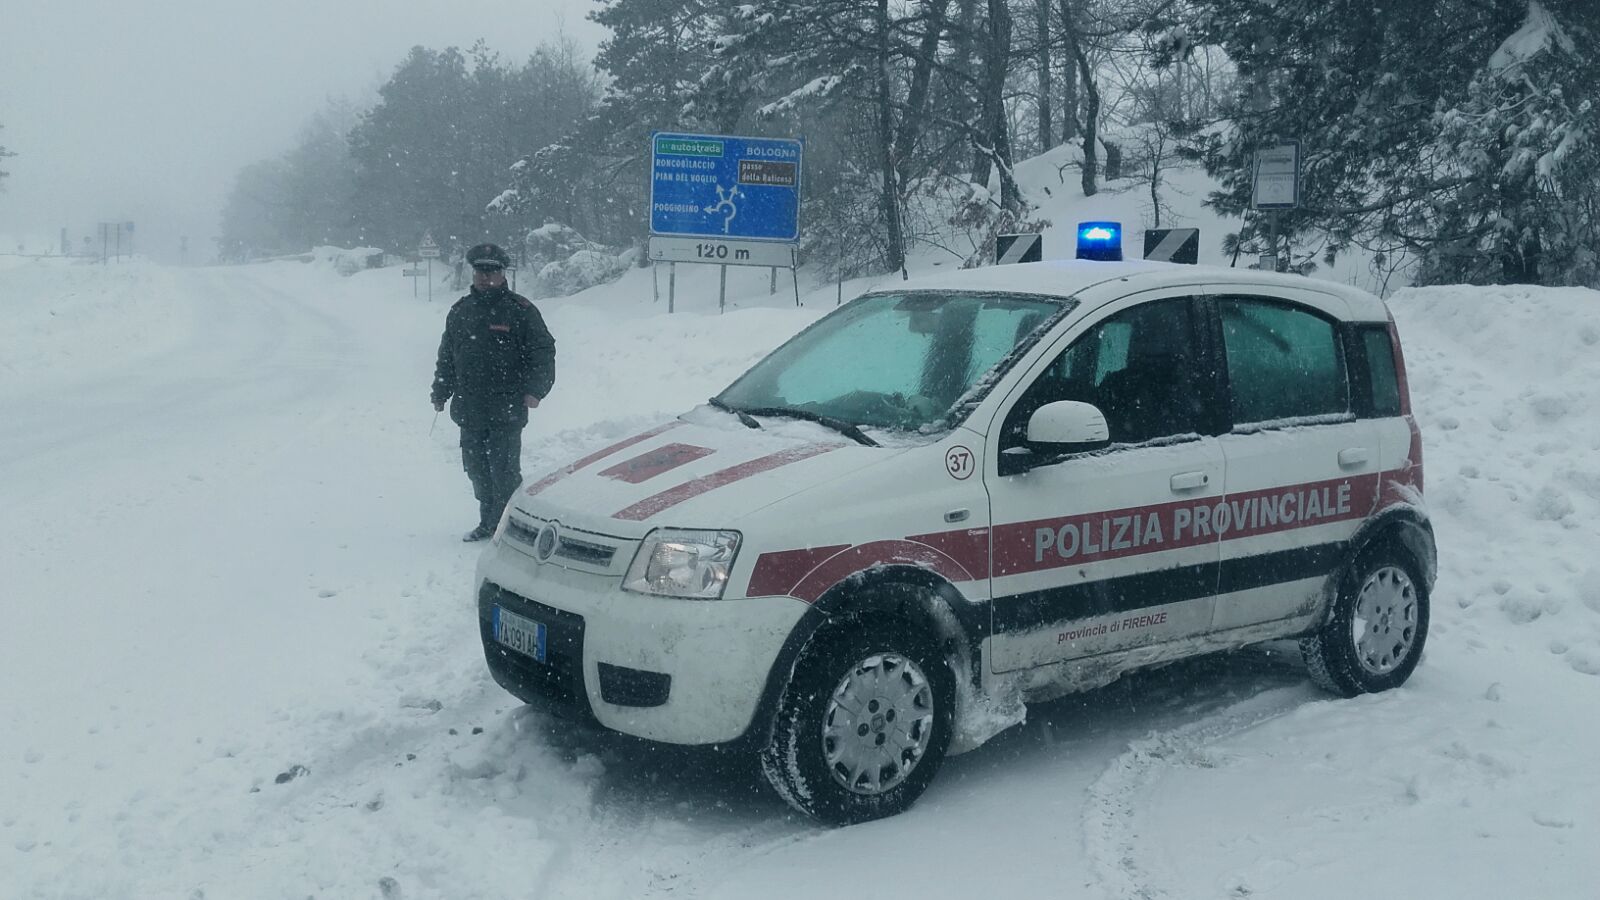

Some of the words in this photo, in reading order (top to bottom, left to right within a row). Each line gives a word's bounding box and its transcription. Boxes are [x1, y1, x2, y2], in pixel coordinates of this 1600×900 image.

[671, 142, 721, 154] autostrada
[746, 147, 796, 158] BOLOGNA
[656, 158, 716, 170] RONCOBILACCIO
[742, 163, 763, 171] passo
[655, 172, 673, 181] PIAN
[675, 173, 688, 182] DEL
[690, 174, 718, 184] VOGLIO
[741, 173, 760, 182] della
[654, 203, 699, 213] POGGIOLINO
[696, 243, 728, 259] 120
[735, 249, 750, 260] m
[949, 452, 969, 473] 37
[1035, 512, 1164, 562] POLIZIA
[1173, 483, 1352, 541] PROVINCIALE
[1057, 623, 1107, 645] provincia
[1110, 620, 1120, 633] di
[1122, 612, 1168, 631] FIRENZE
[500, 620, 509, 644] YA
[511, 627, 526, 652] 091
[527, 634, 538, 657] AH
